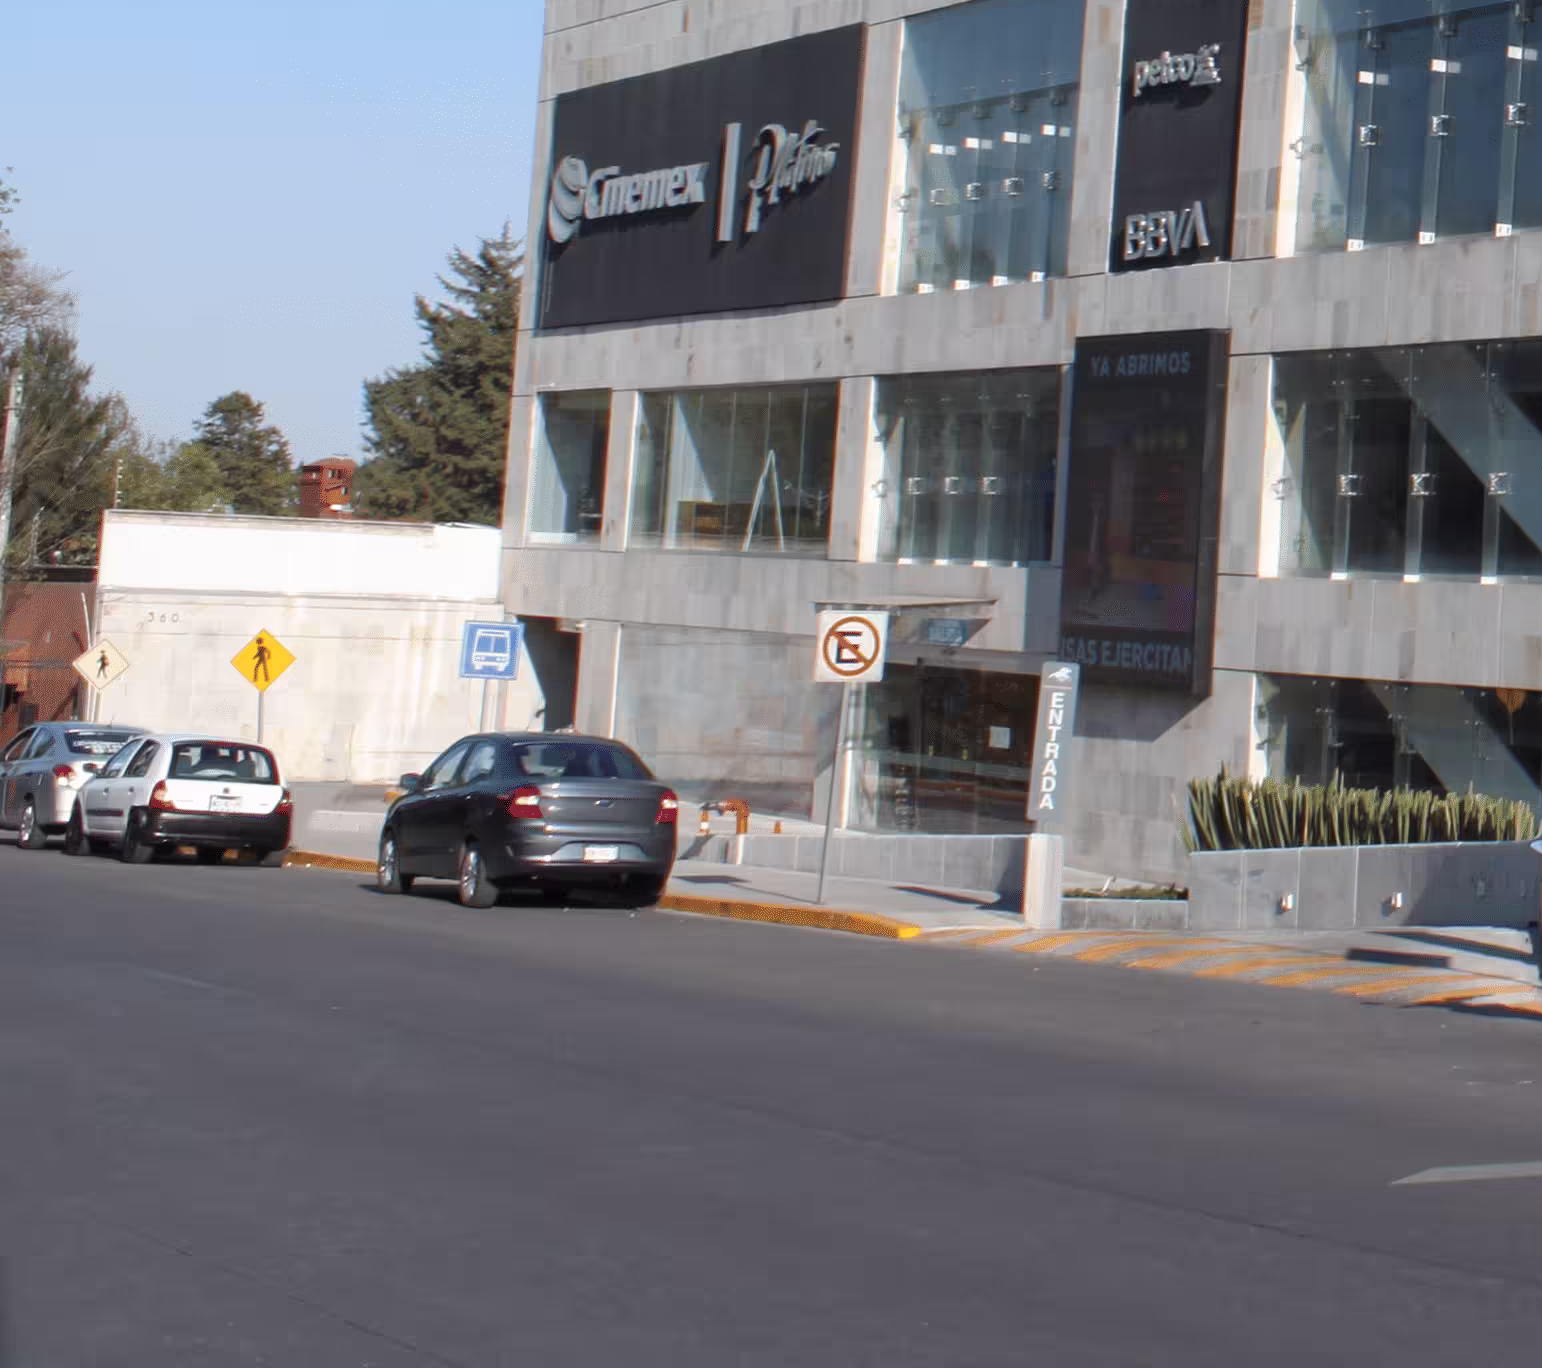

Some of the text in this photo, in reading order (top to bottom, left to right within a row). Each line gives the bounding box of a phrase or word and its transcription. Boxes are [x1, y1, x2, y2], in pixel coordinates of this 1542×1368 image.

[1134, 50, 1195, 98] petco
[1123, 200, 1210, 261] BBVA
[1089, 351, 1192, 377] YA ABRIMOS
[1039, 692, 1066, 810] ENTRADA
